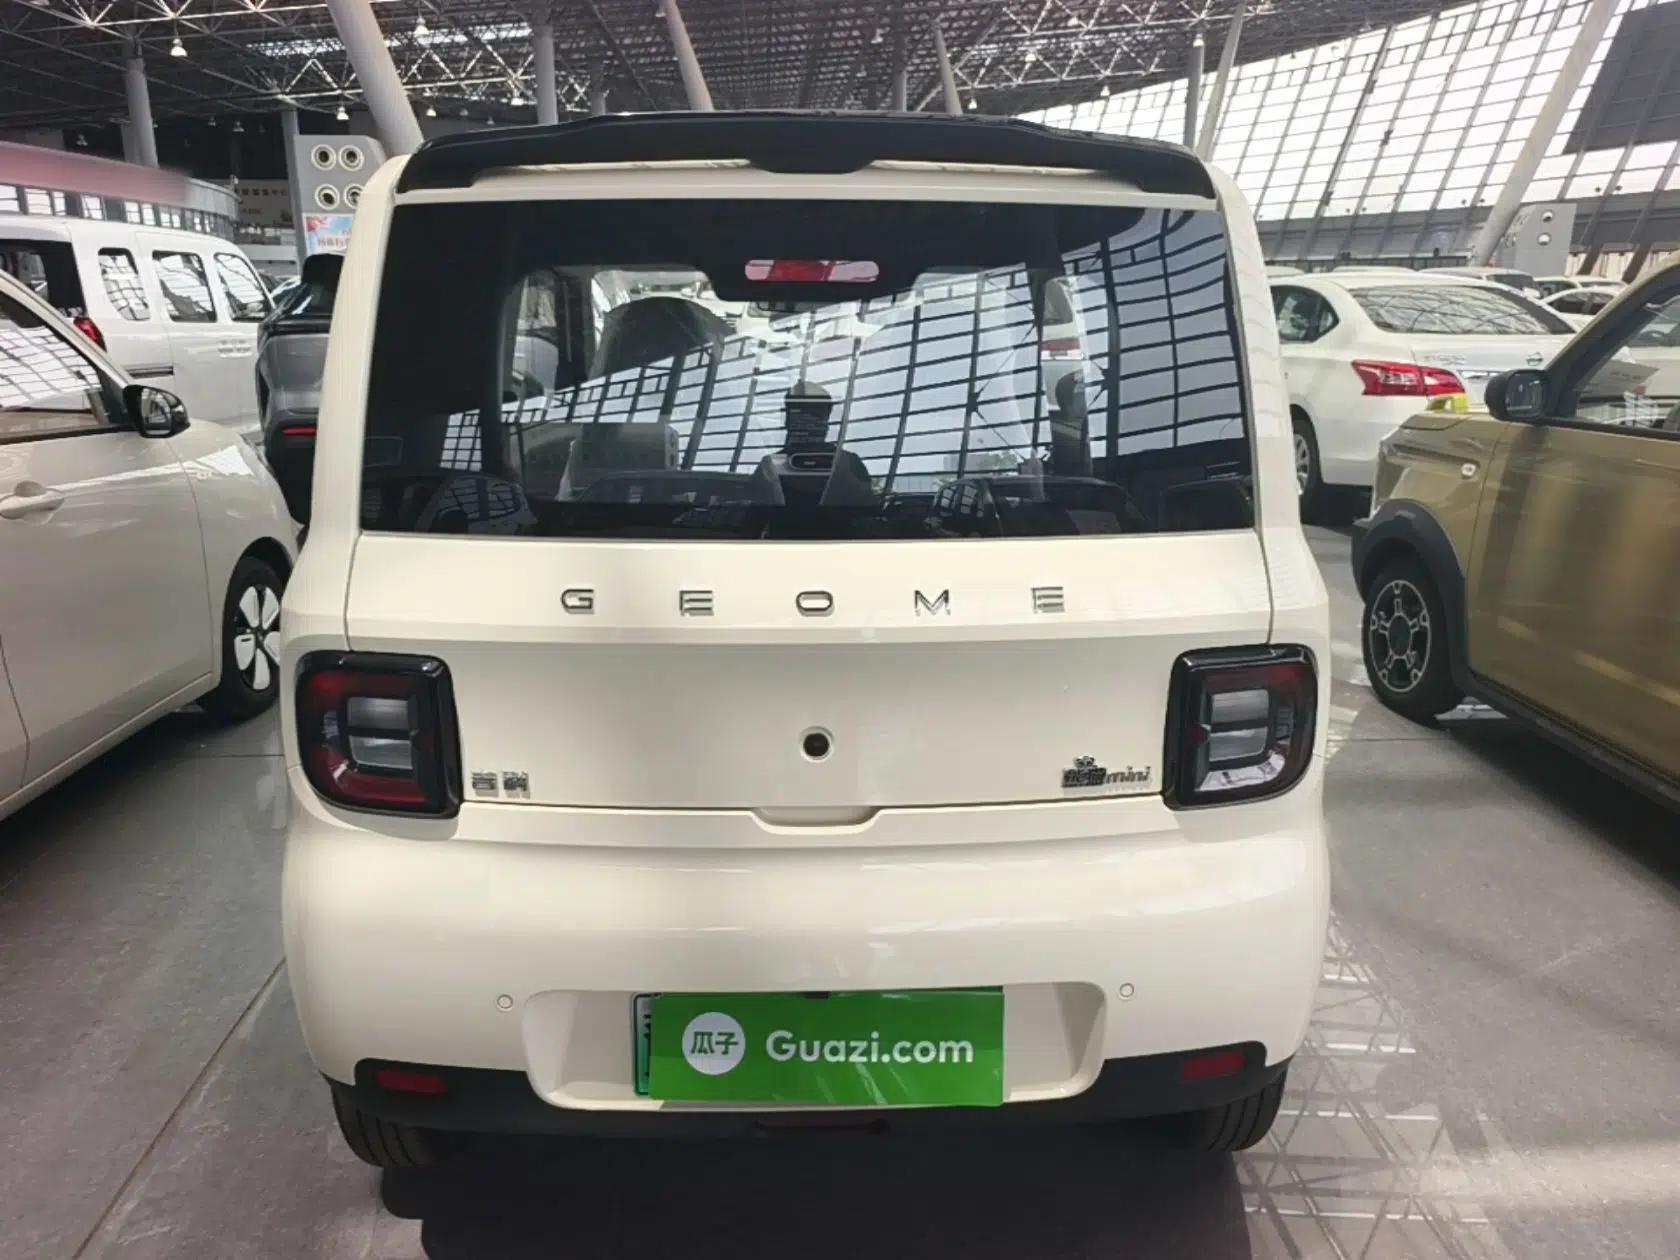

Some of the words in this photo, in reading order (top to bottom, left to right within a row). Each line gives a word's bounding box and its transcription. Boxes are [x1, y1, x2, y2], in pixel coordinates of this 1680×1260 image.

[561, 586, 1065, 616] GEOME
[690, 1031, 739, 1055] 瓜子
[766, 1030, 974, 1064] Guazi.com
